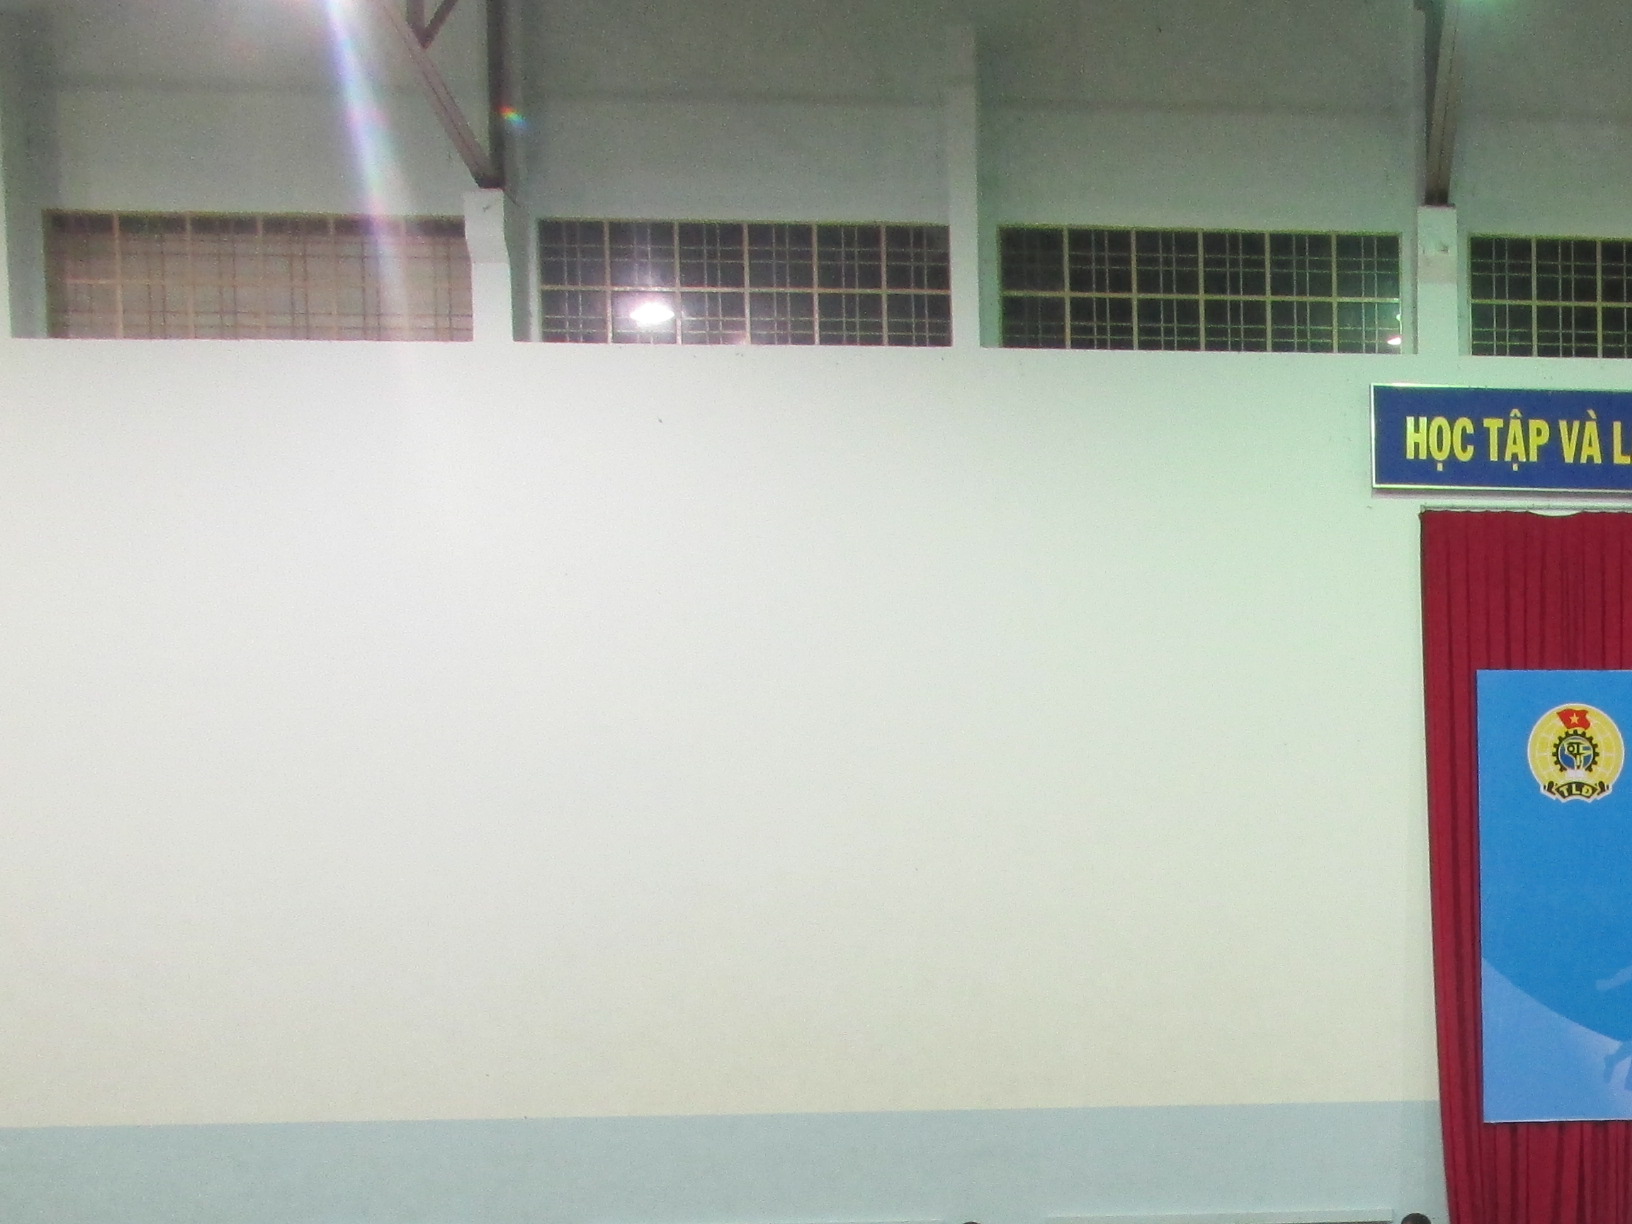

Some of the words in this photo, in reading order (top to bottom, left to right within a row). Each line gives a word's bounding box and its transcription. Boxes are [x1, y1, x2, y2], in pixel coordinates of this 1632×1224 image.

[1405, 415, 1474, 472] HỌC
[1483, 409, 1550, 472] TẬP
[1559, 409, 1602, 465] VÀ
